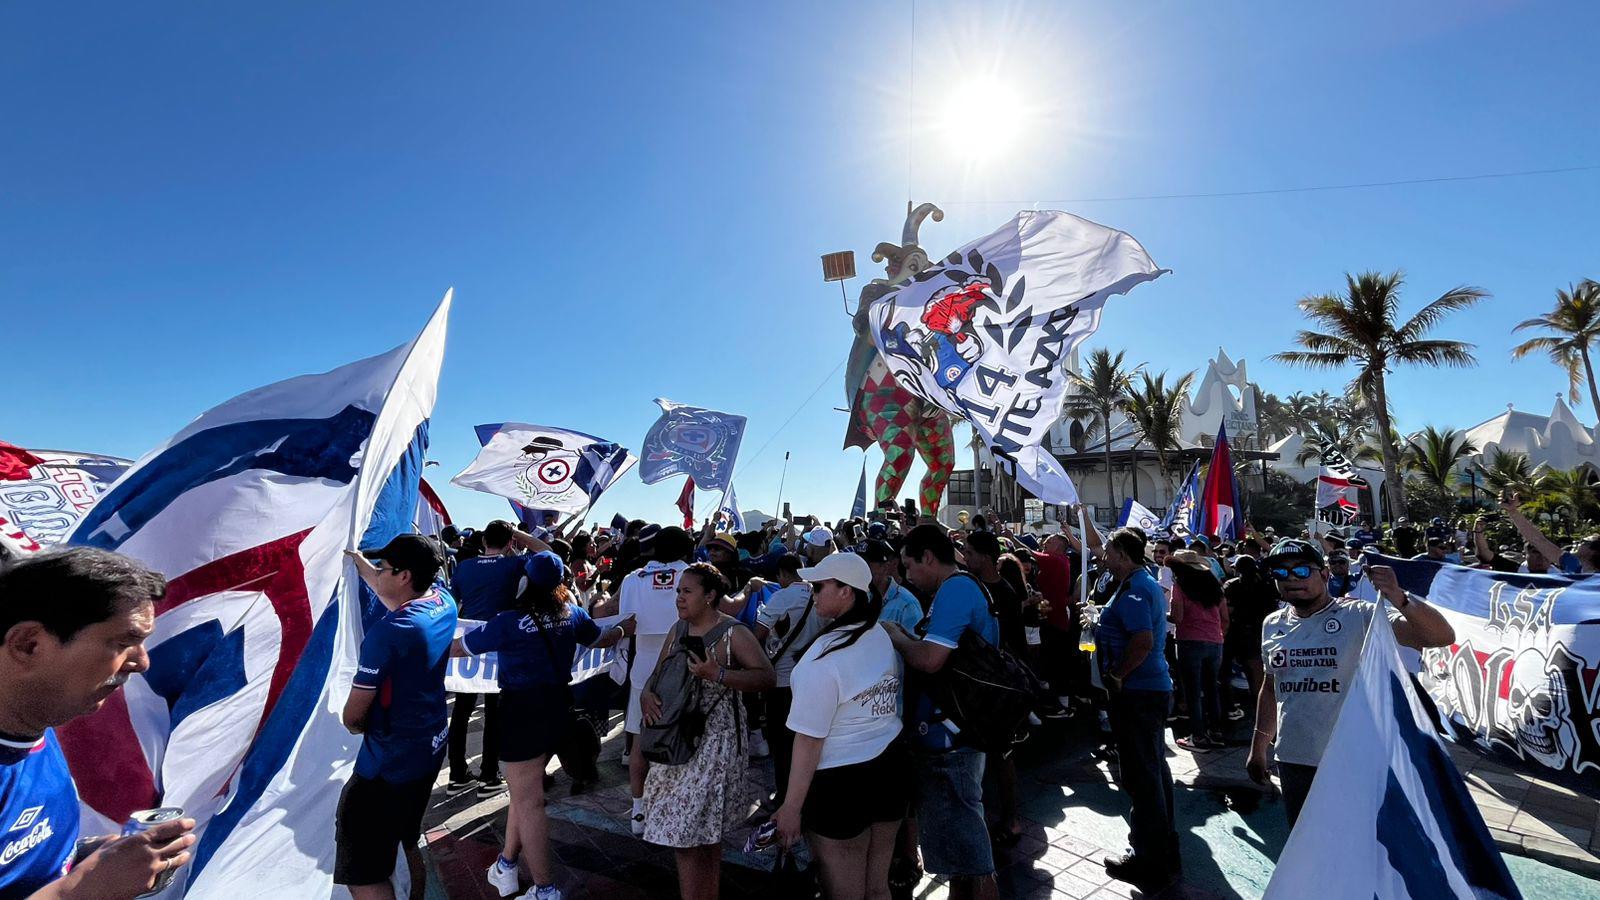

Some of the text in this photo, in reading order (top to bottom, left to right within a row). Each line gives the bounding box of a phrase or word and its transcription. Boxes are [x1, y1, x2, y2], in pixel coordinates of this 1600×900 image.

[957, 361, 1021, 428] 14
[1289, 646, 1338, 657] CEMENTO
[1290, 658, 1338, 668] CRUZ AZUL
[1279, 677, 1341, 694] novibet
